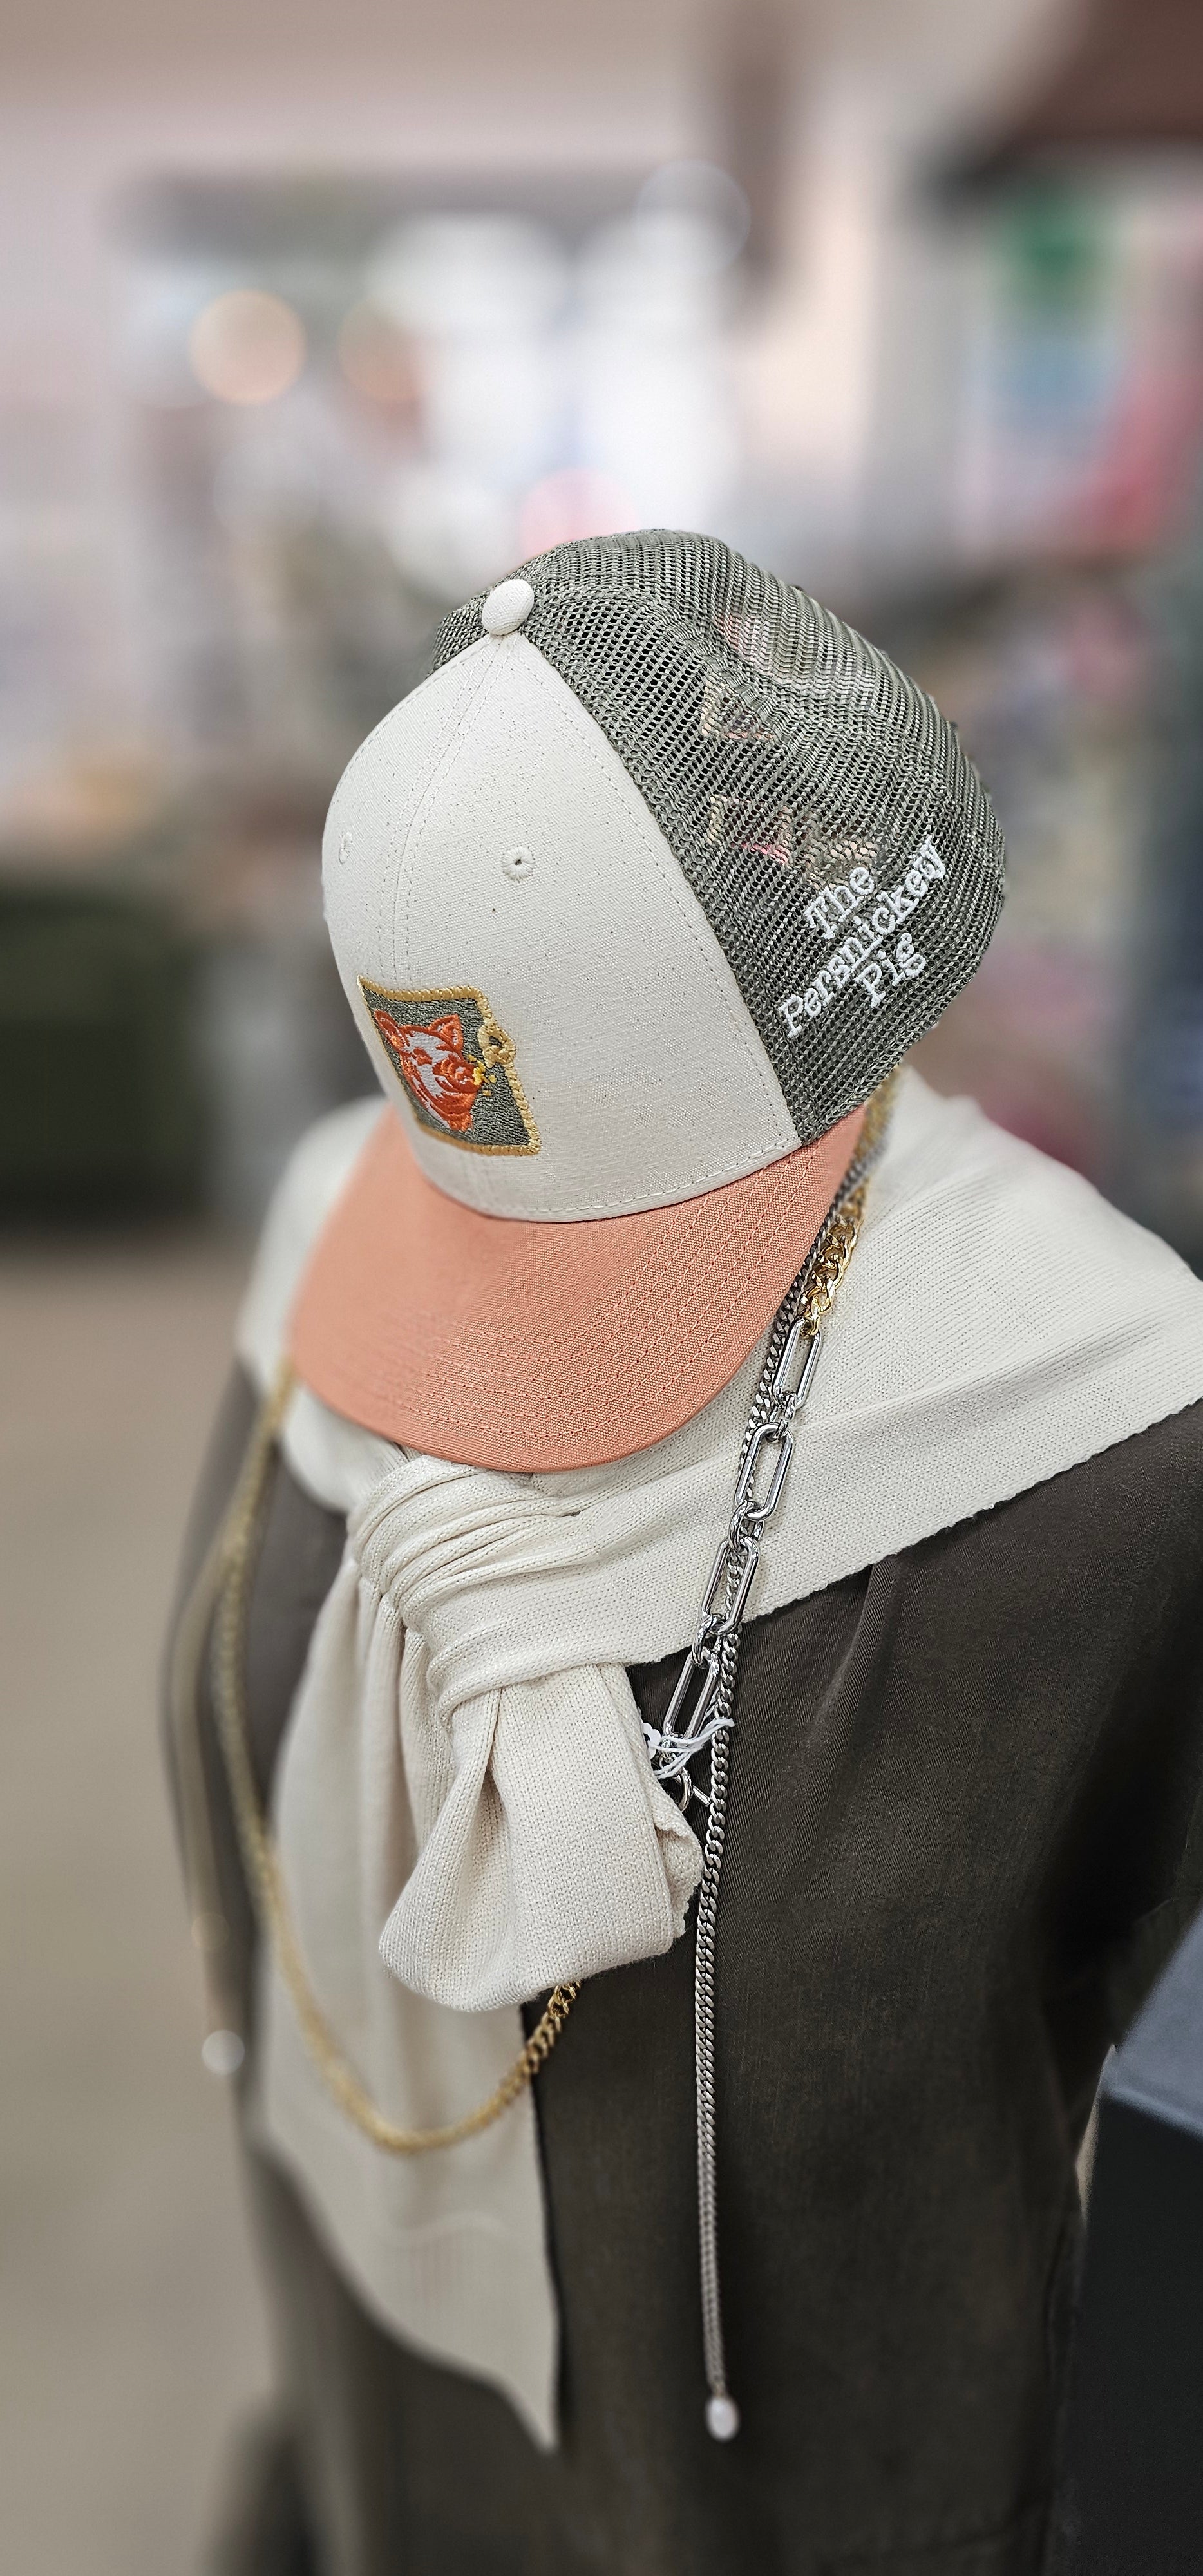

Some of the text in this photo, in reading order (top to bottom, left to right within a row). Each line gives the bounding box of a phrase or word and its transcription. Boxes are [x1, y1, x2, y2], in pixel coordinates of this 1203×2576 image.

[779, 836, 945, 1038] Persnickey
[805, 867, 875, 939] The
[855, 933, 926, 1008] Pig
